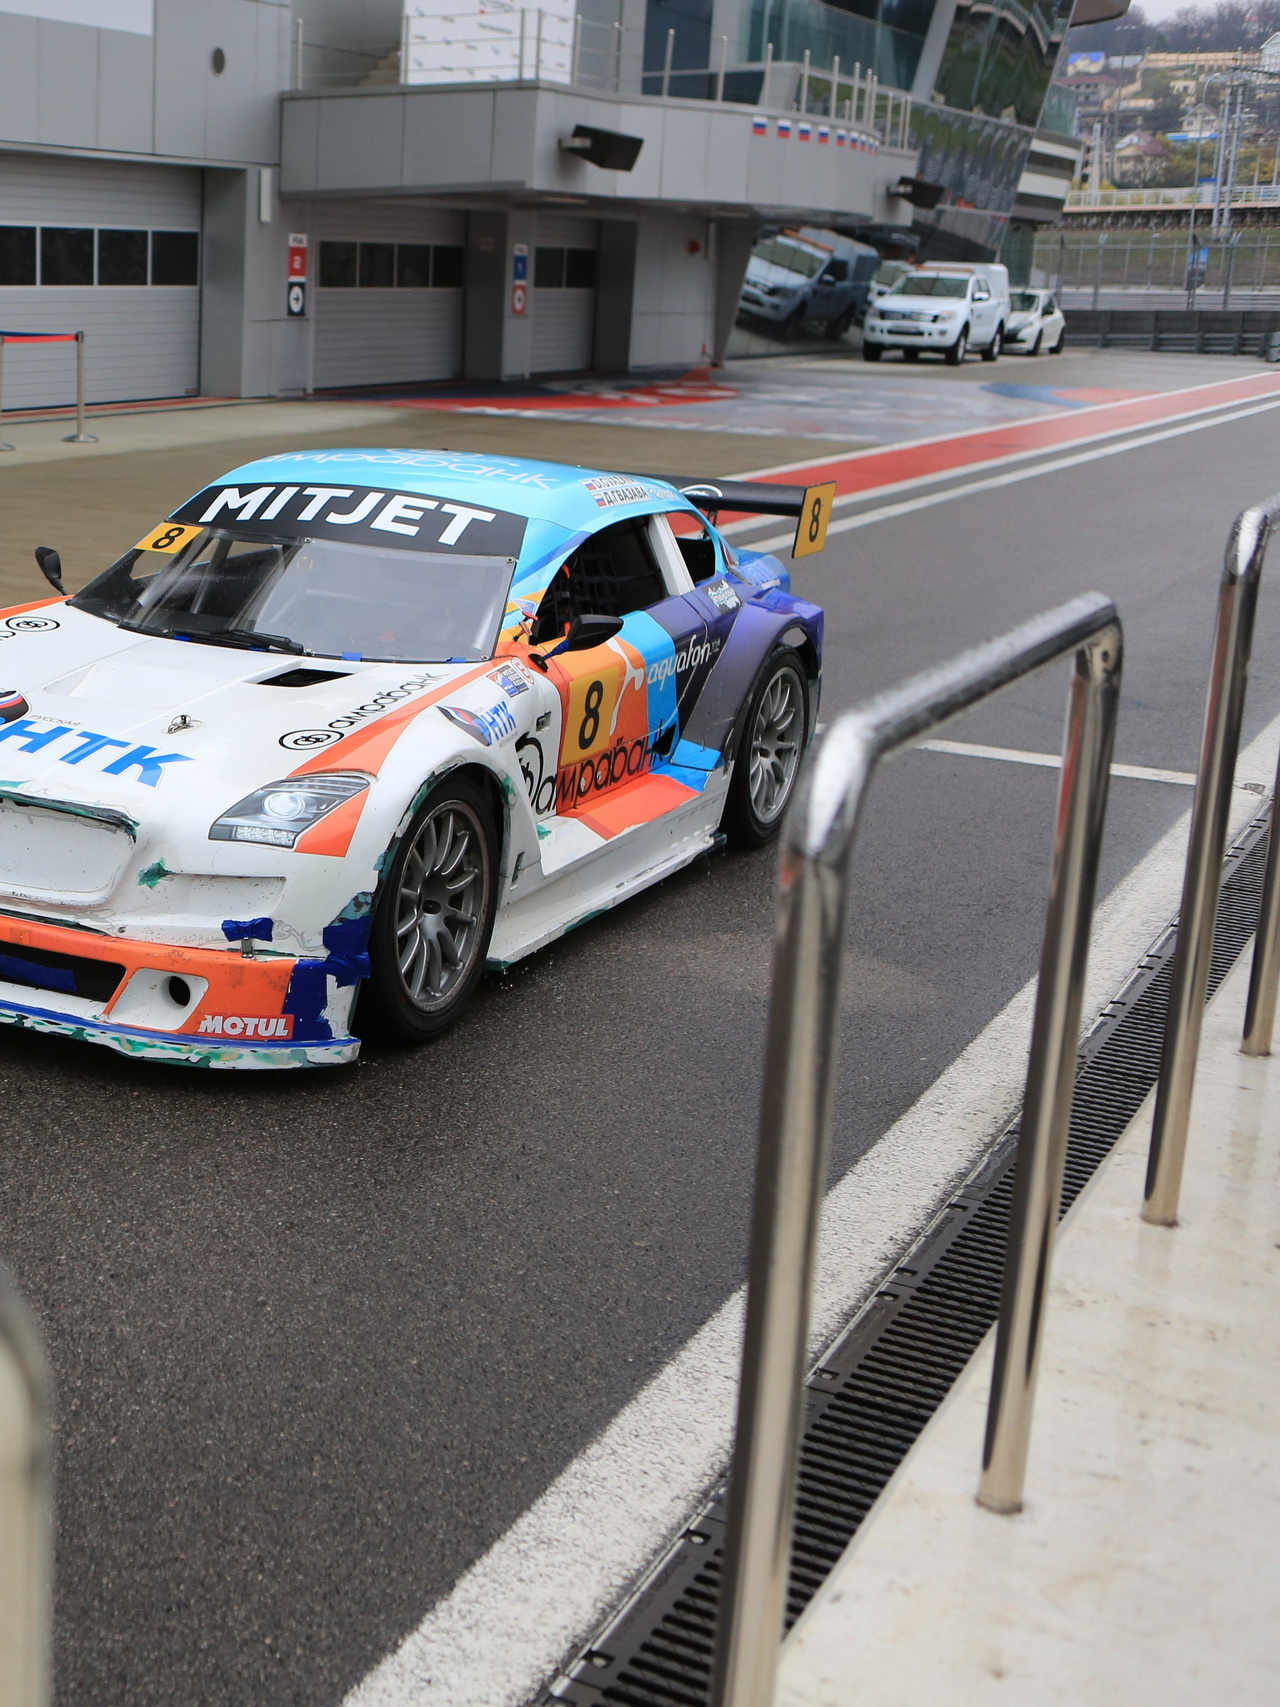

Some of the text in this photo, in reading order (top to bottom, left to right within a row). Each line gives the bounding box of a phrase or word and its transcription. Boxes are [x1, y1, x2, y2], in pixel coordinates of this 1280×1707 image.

[293, 256, 302, 269] 2
[151, 526, 186, 549] 8
[198, 486, 496, 547] MITJET
[808, 497, 822, 543] 8
[647, 634, 711, 691] aquafon
[578, 680, 604, 750] 8
[198, 1014, 289, 1037] MOTUL
